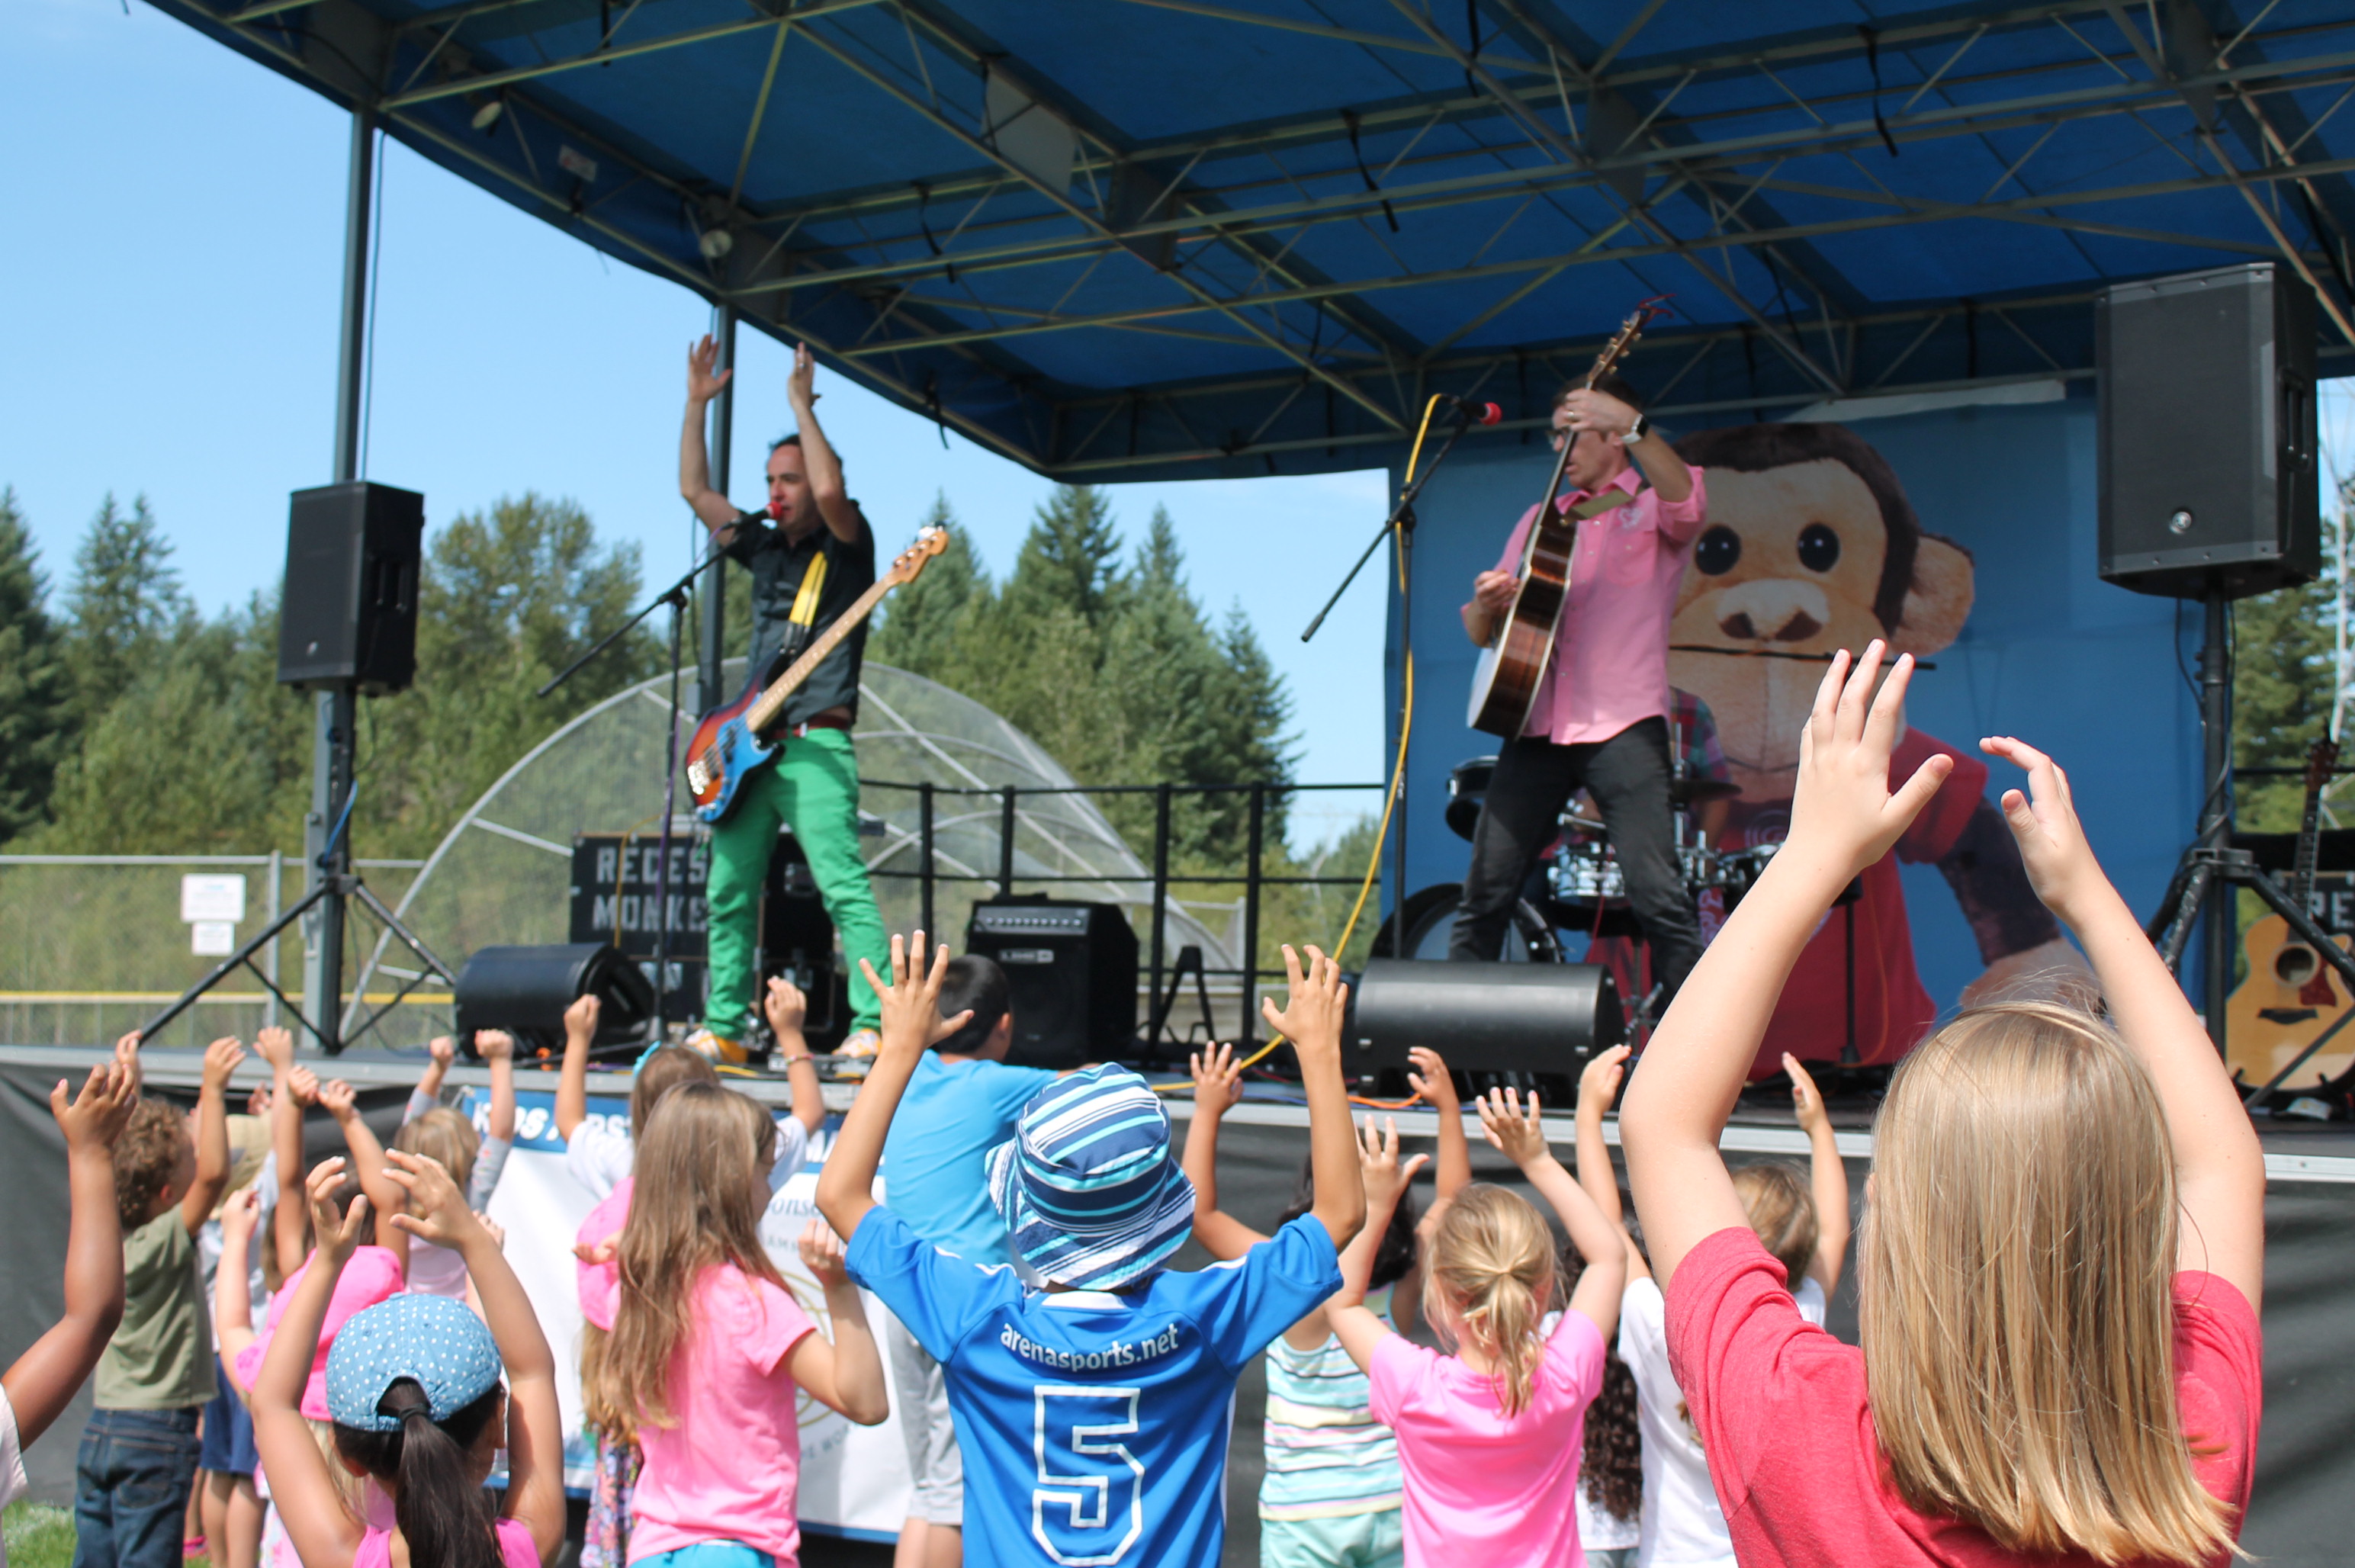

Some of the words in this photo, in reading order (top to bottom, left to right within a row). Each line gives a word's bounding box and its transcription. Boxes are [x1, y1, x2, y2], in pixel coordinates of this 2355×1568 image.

[596, 846, 709, 884] RECES
[592, 894, 708, 932] MONKE
[471, 1101, 550, 1140] KDS
[1000, 1322, 1179, 1372] arenasports.net
[1031, 1383, 1146, 1566] 5
